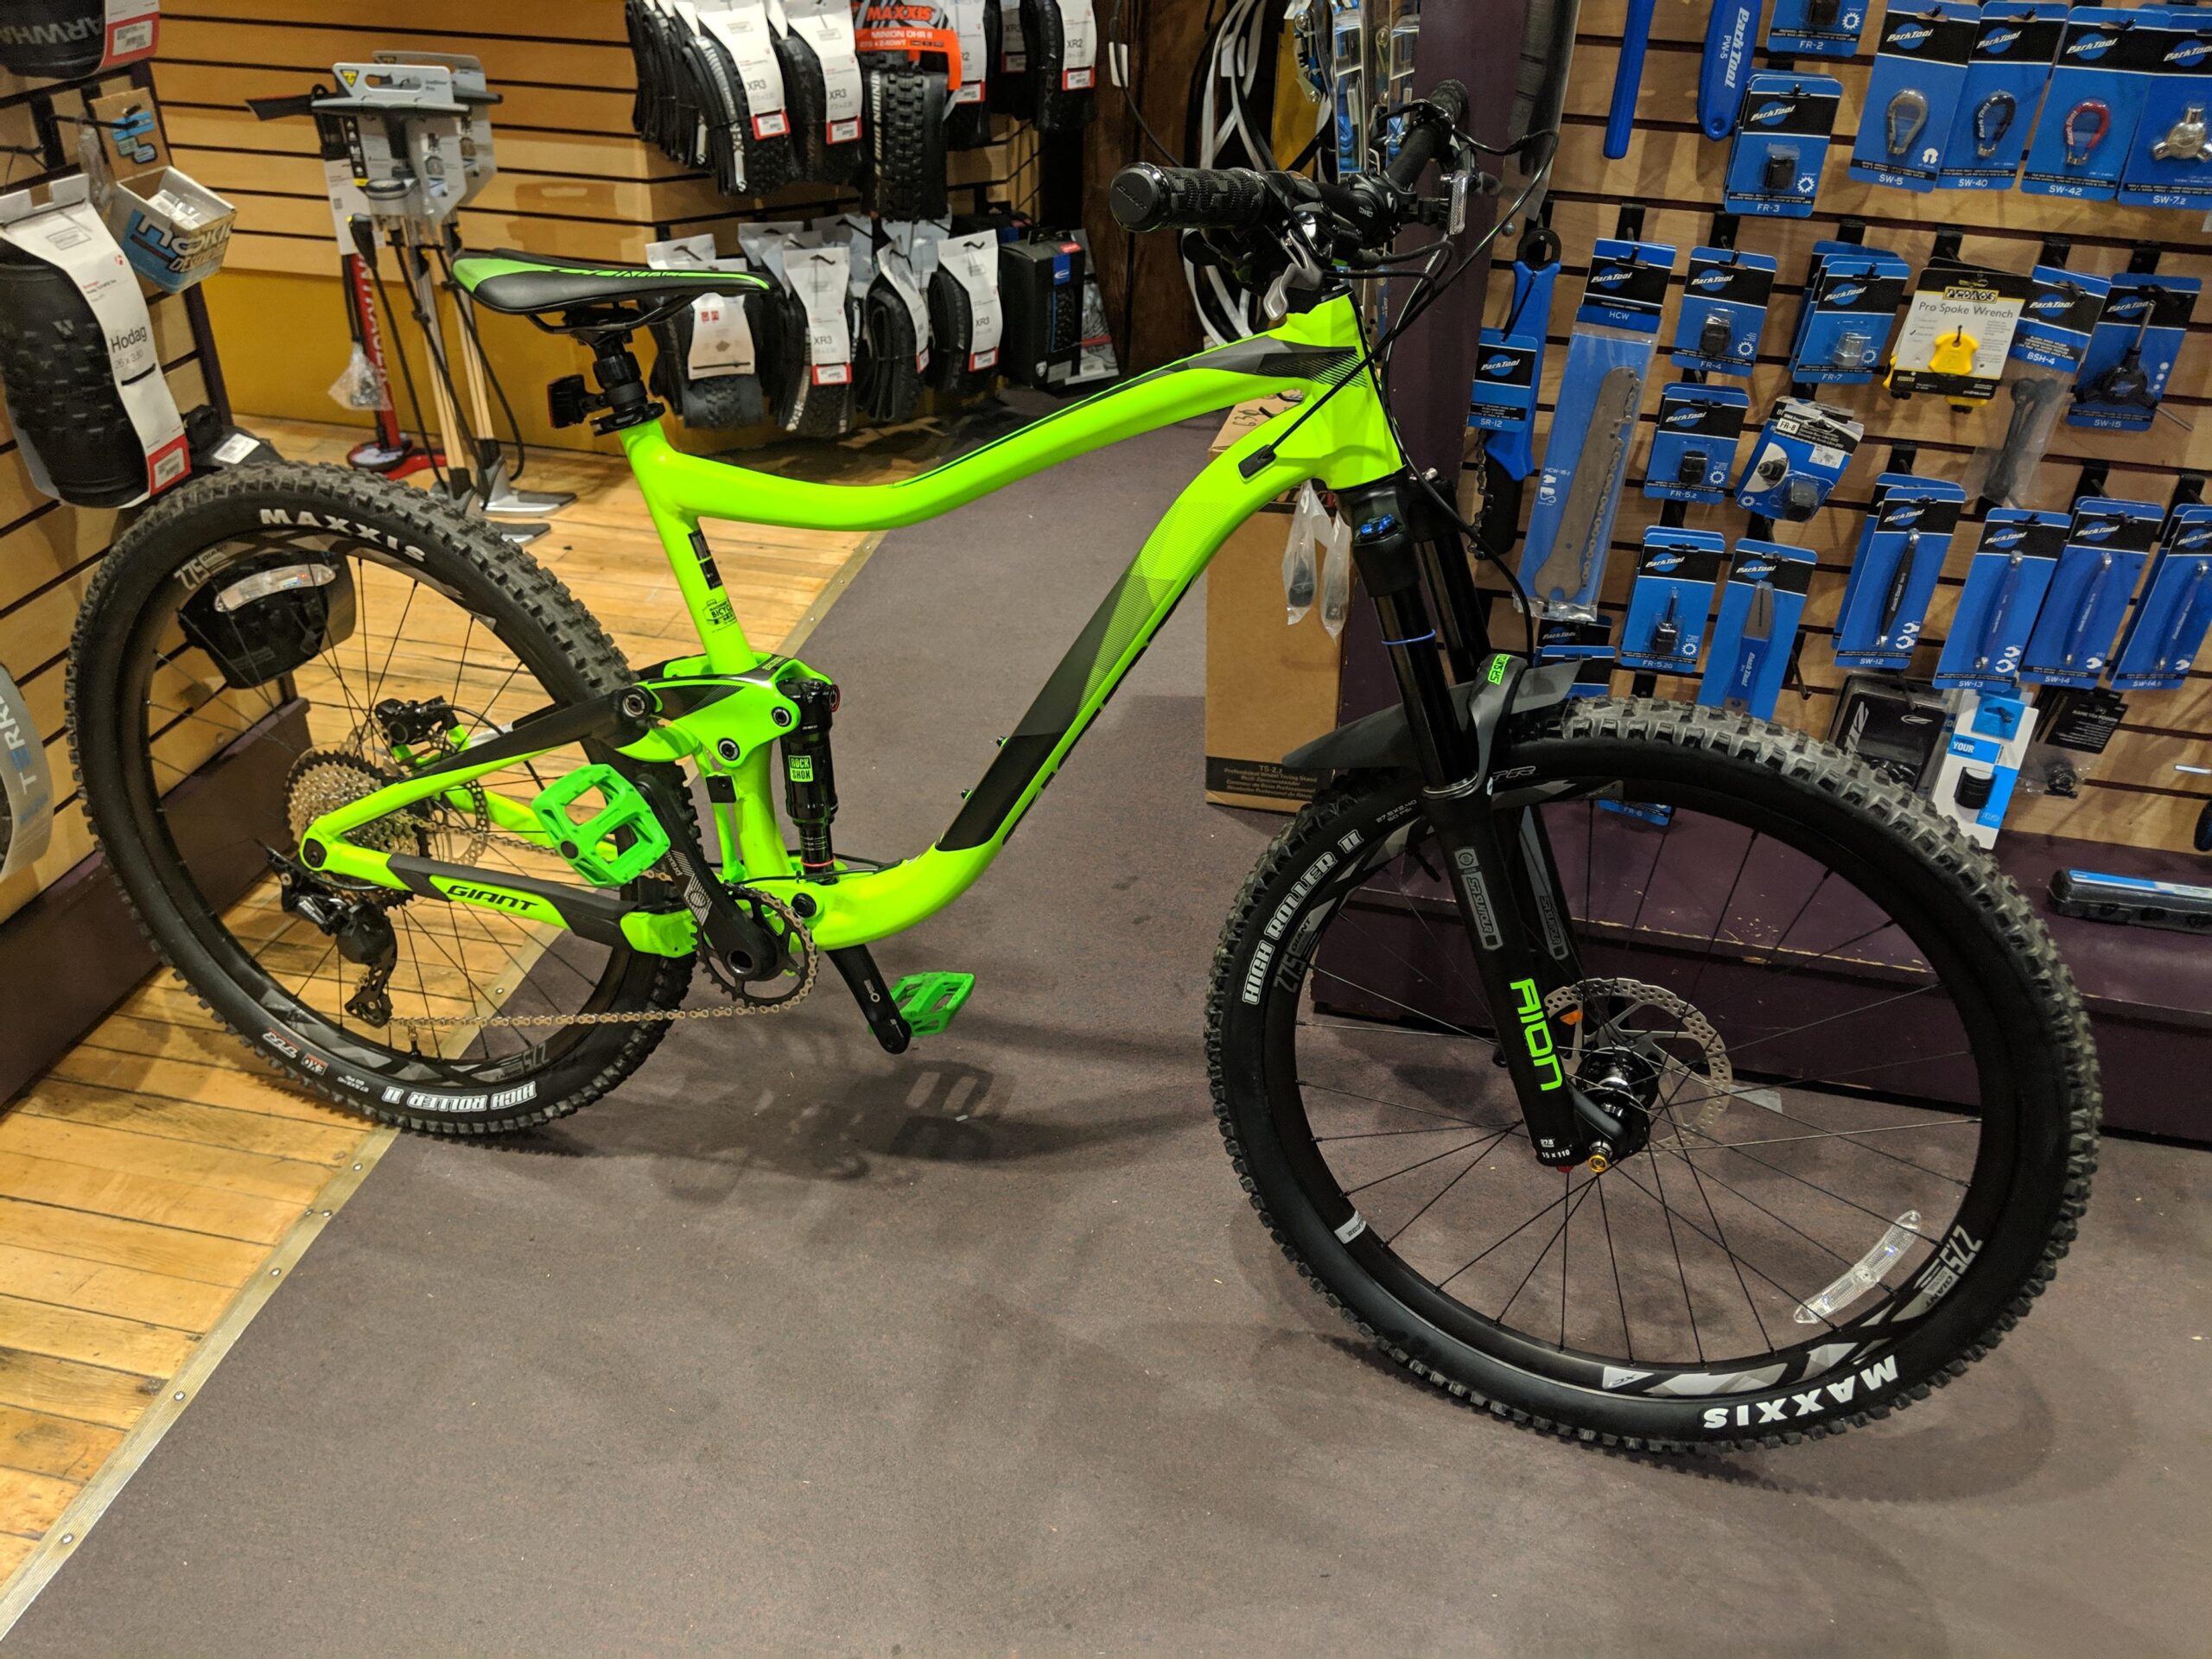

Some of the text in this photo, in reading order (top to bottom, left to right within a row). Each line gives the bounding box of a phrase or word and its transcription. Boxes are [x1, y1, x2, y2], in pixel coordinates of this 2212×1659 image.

[867, 5, 934, 22] MAXXIS
[871, 30, 905, 39] MINION
[906, 30, 926, 39] DHR
[1067, 39, 1084, 48] XR2
[1719, 35, 1732, 60] PW-5
[1799, 40, 1824, 50] FR-2
[747, 79, 767, 92] XR3
[829, 89, 847, 100] XR3
[1878, 174, 1904, 186] SW-5
[1958, 179, 1987, 188] SW-40
[2049, 185, 2083, 196] SW-42
[2152, 195, 2187, 206] SW-7.2
[1757, 203, 1781, 213] FR-3
[1609, 311, 1630, 321] HCW
[1918, 302, 2013, 319] Pro Spoke Wrench
[976, 316, 990, 327] XR3
[110, 326, 147, 353] Hodag
[813, 335, 833, 345] XR3
[2026, 353, 2056, 365] BSH-4
[1700, 360, 1722, 371] FR-4
[1480, 418, 1503, 428] SR-12
[1780, 421, 1797, 431] FR-8
[2094, 419, 2122, 428] SW-15
[1669, 490, 1697, 499] FR-5.2
[260, 508, 426, 562] MAXXIS
[1958, 680, 1984, 689] SW-13
[1953, 741, 1975, 754] YOUR
[791, 757, 810, 769] ROCK
[791, 769, 810, 779] SHOX
[447, 885, 540, 911] GIANT
[1243, 829, 1364, 1005] HIGH ROLLER II
[1291, 917, 1312, 950] GIANT
[1510, 978, 1563, 1091] AION
[381, 1080, 537, 1113] HIGH ROLLER II
[1557, 1148, 1571, 1158] 110
[1925, 1274, 1955, 1310] GIANT
[1703, 1354, 1898, 1430] MAXXIS
